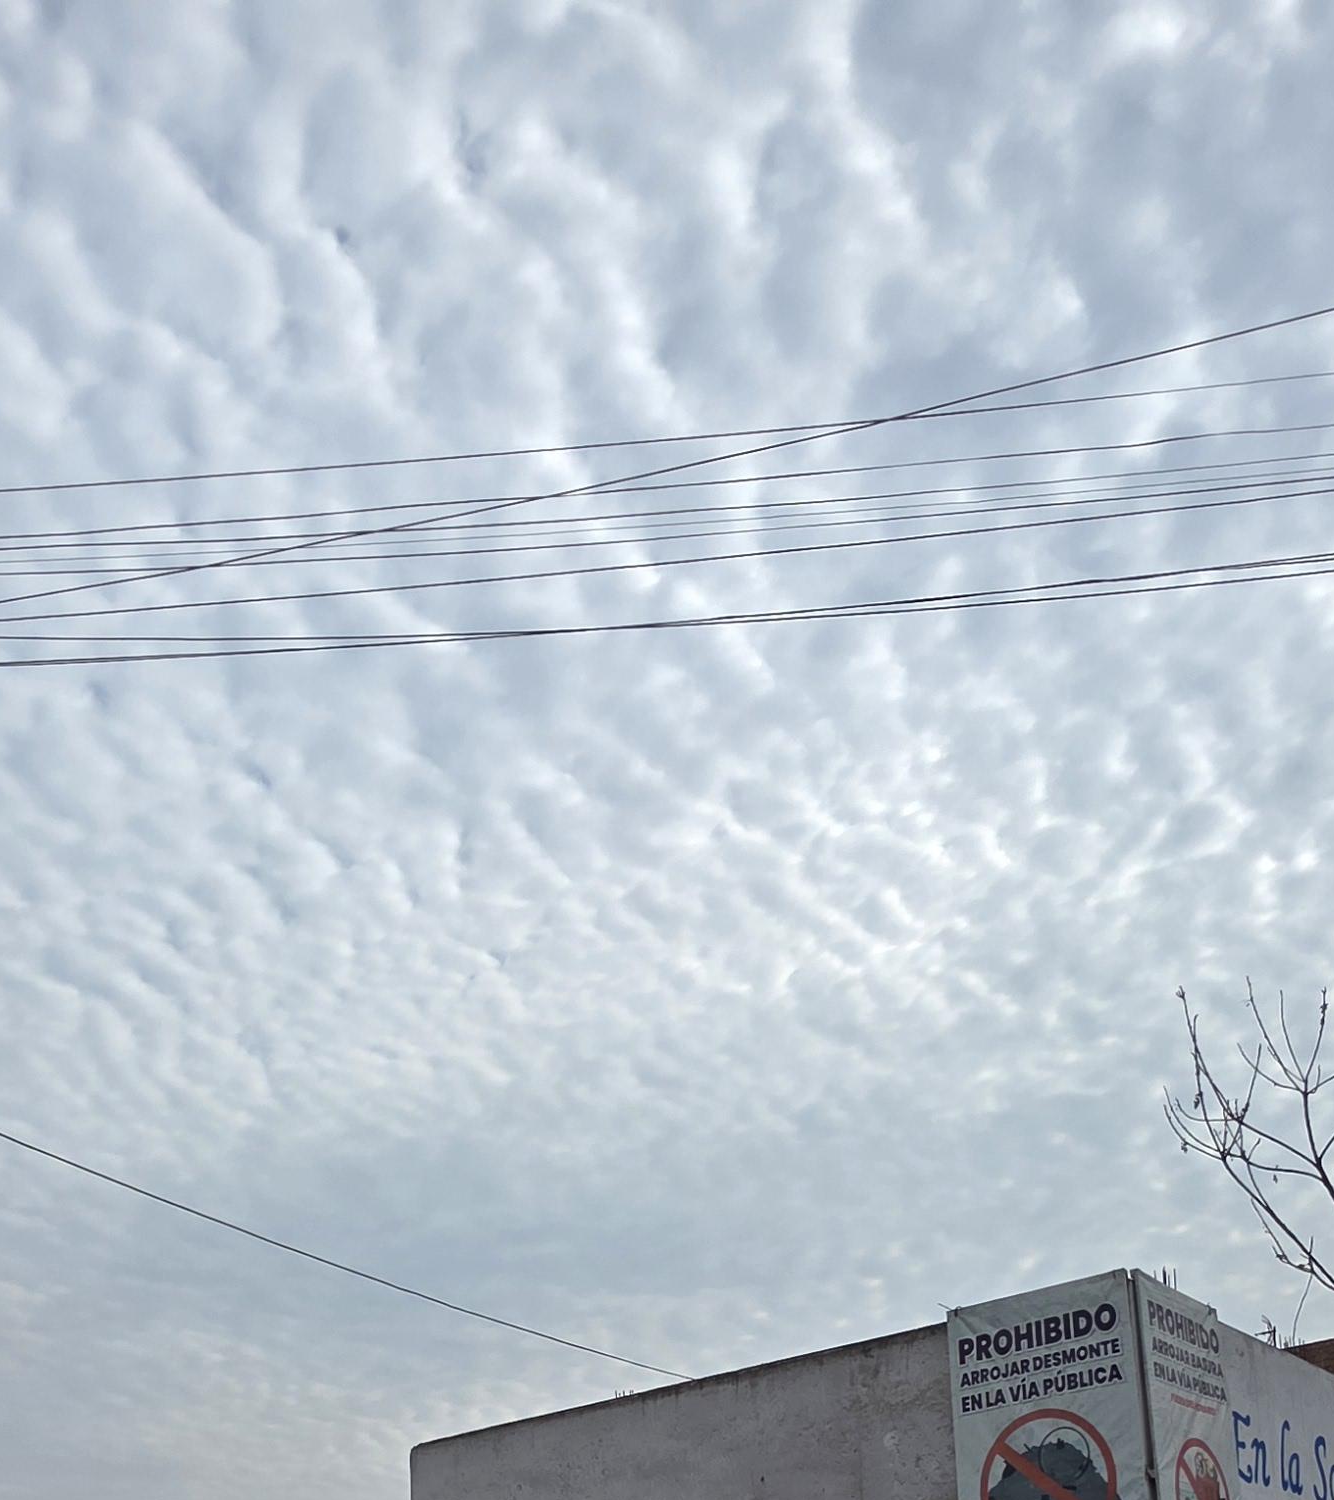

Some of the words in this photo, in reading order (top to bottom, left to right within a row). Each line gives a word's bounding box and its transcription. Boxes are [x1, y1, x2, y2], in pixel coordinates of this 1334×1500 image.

[958, 1303, 1117, 1365] PROHIBIDO
[1147, 1299, 1219, 1354] PROHIBIDO
[960, 1358, 1031, 1388] ARROJAR
[1032, 1338, 1121, 1371] DESMONTE
[961, 1393, 983, 1413] EN
[985, 1388, 1007, 1408] LA
[1008, 1377, 1041, 1402] VÍA
[1042, 1363, 1123, 1396] PÚBLICA
[1231, 1410, 1271, 1488] En
[1280, 1419, 1304, 1496] la
